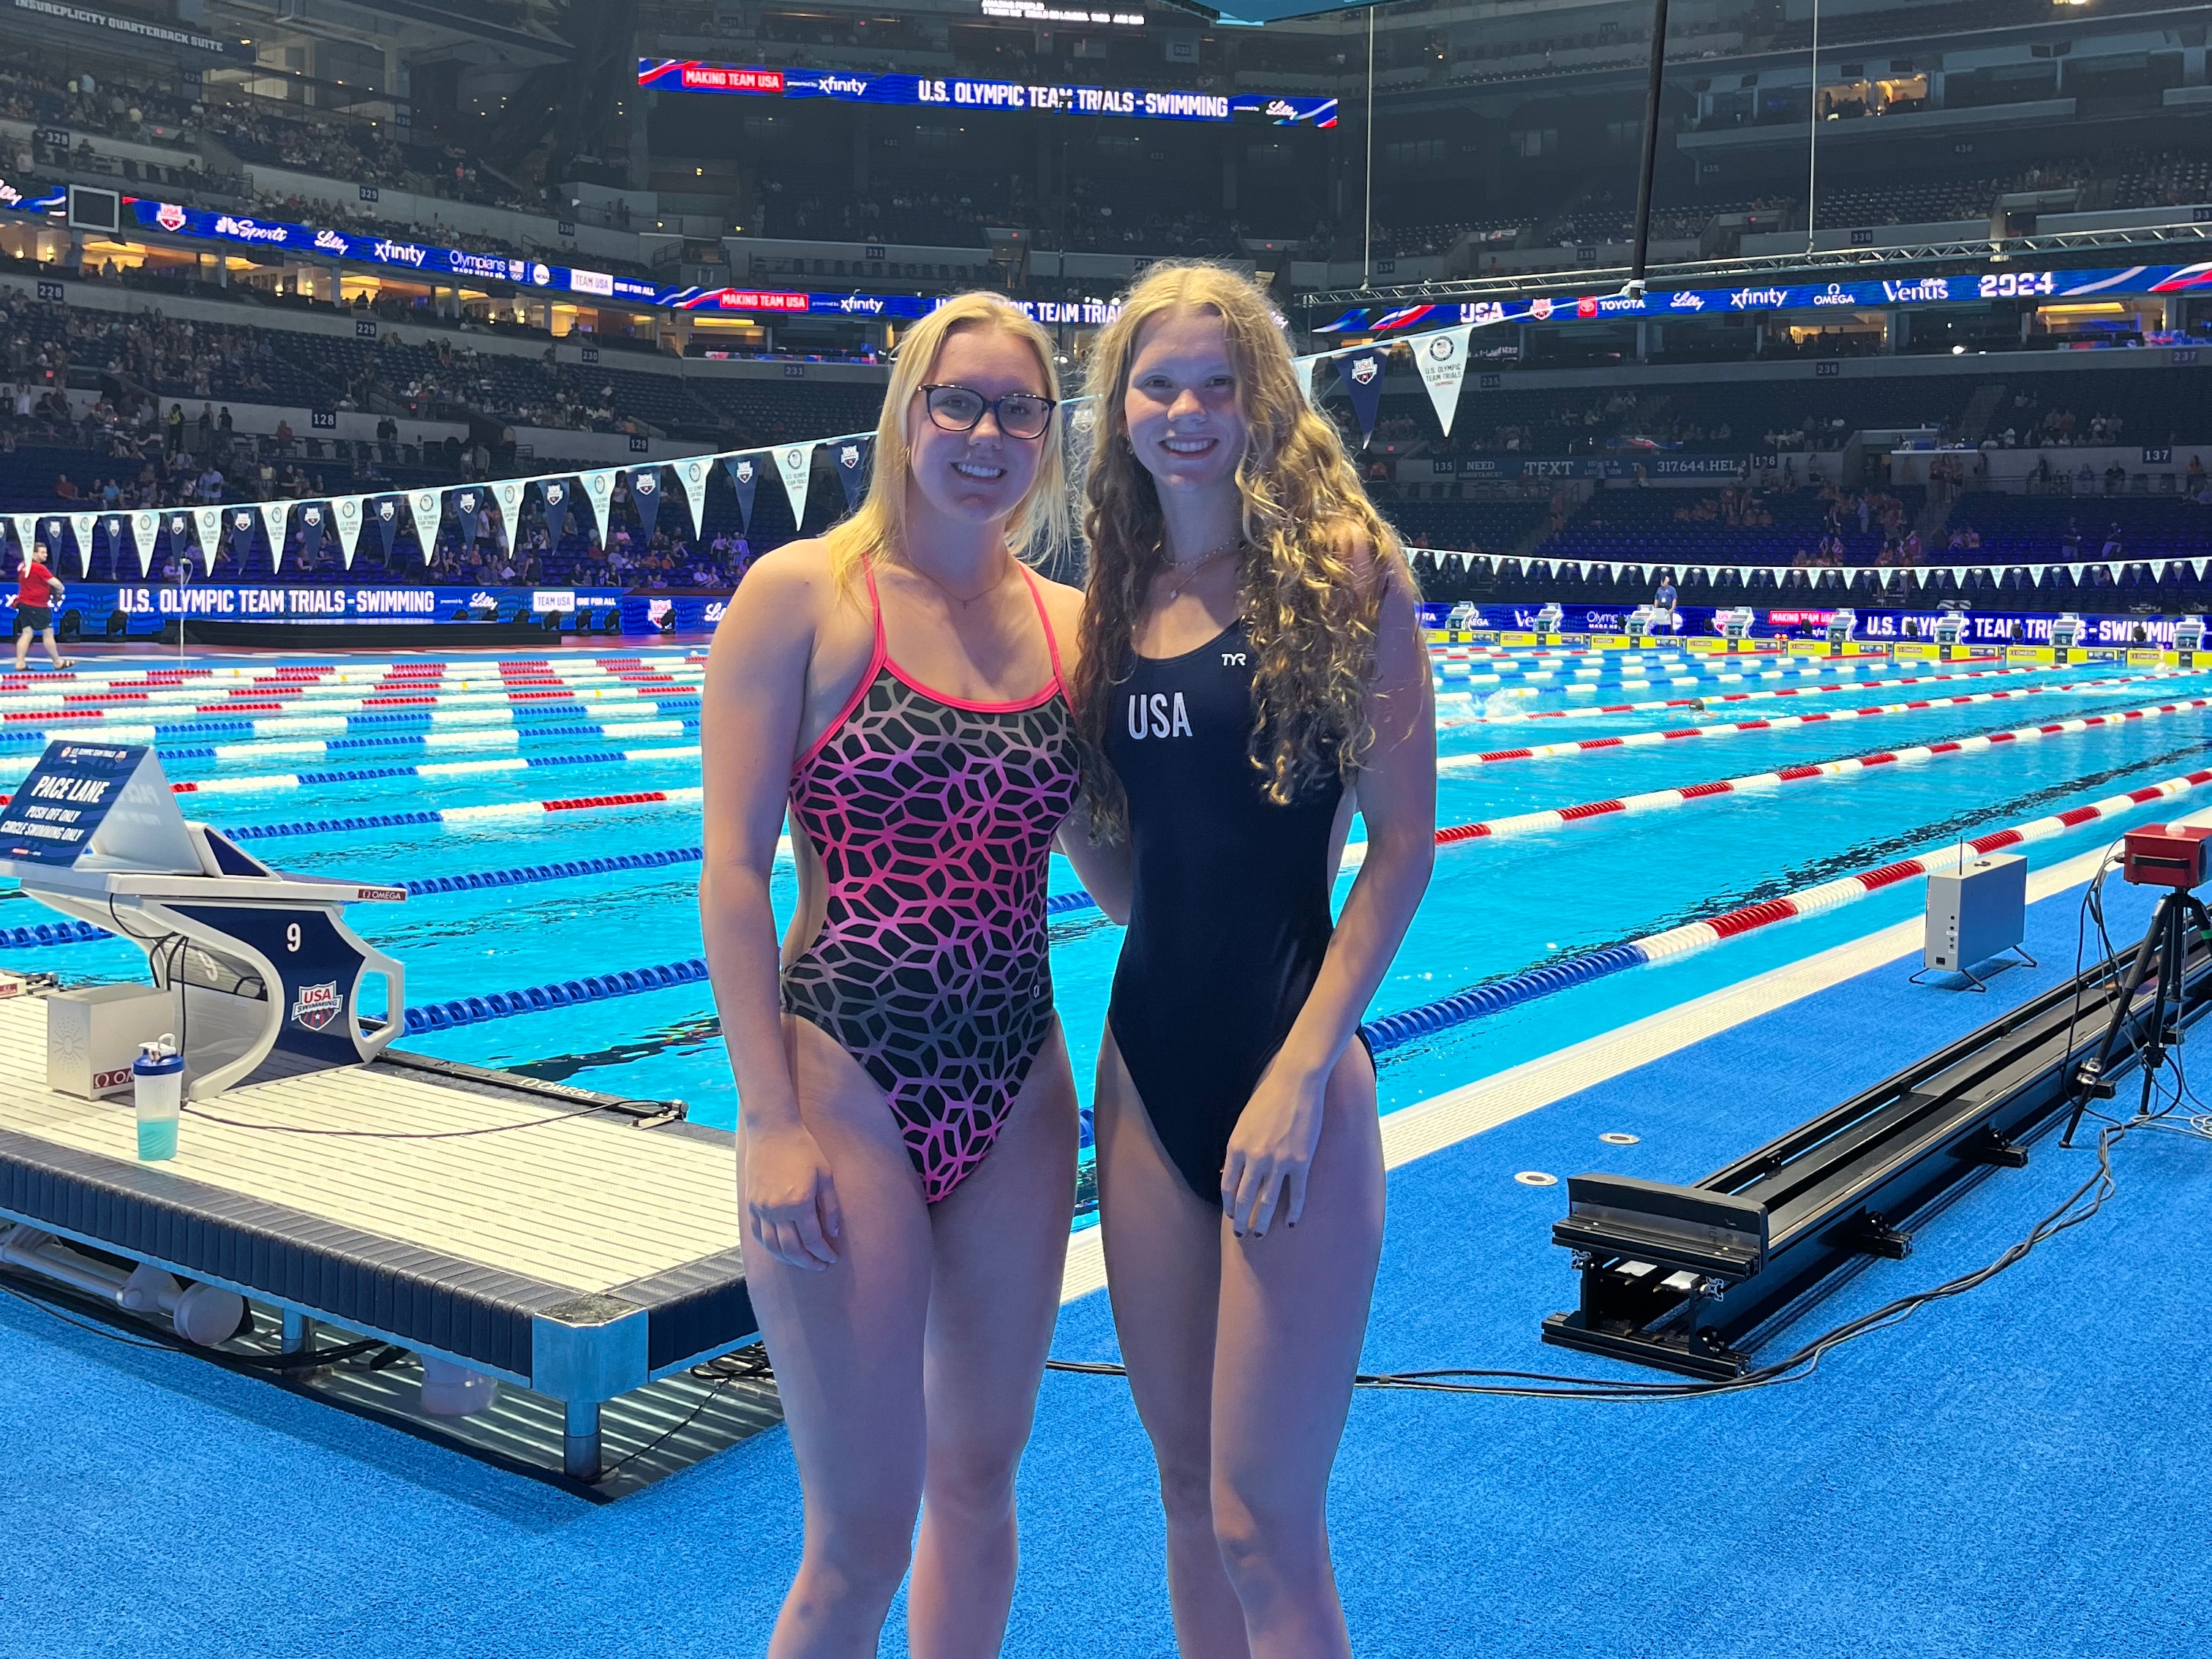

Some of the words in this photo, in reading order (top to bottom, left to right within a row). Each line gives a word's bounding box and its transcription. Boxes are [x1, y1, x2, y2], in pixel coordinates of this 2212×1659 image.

[108, 18, 188, 44] QUARTERBACK
[191, 36, 223, 52] SUITE
[686, 71, 726, 85] MAKING
[728, 72, 756, 86] TEAM
[757, 75, 780, 89] USA
[819, 77, 867, 96] xfinity
[919, 80, 950, 102] U.S.
[955, 83, 1025, 106] OLYMPIC
[1265, 100, 1298, 120] Lilly
[361, 189, 377, 199] 329
[560, 224, 573, 233] 330
[163, 207, 178, 216] USA
[238, 220, 287, 241] Sports
[315, 230, 349, 255] Lilly
[375, 240, 426, 266] xfinity
[868, 249, 883, 257] 331
[450, 251, 505, 272] Olympians
[40, 285, 62, 298] 228
[575, 274, 593, 286] TEAM
[596, 279, 609, 290] USA
[642, 286, 655, 296] ALL
[1883, 280, 1949, 301] Venus
[723, 294, 758, 306] MAKING
[760, 295, 784, 307] TEAM
[786, 296, 805, 308] USA
[840, 296, 884, 313] xfinity
[1461, 301, 1505, 323] USA
[1600, 299, 1645, 310] TOYOTA
[1670, 291, 1705, 310] Lilly
[1731, 288, 1787, 309] xfinity
[1814, 294, 1855, 305] OMEGA
[1037, 302, 1079, 323] TEAM
[358, 325, 375, 334] 229
[583, 351, 597, 361] 230
[786, 367, 803, 375] 231
[1358, 362, 1371, 370] USA
[1818, 365, 1837, 374] 236
[1426, 374, 1441, 382] TEAM
[1442, 371, 1462, 380] TRIALS
[1481, 377, 1500, 385] 235
[315, 413, 334, 426] 128
[631, 439, 647, 449] 129
[2146, 450, 2169, 461] 137
[1435, 462, 1453, 470] 135
[1467, 461, 1495, 470] NEED
[119, 588, 154, 612] U.S.
[159, 589, 235, 612] OLYMPIC
[238, 590, 285, 612] TEAM
[470, 592, 498, 610] Lilly
[538, 596, 555, 606] TEAM
[557, 598, 571, 608] USA
[603, 598, 617, 606] ALL
[654, 603, 669, 612] USA
[1718, 612, 1728, 620] US
[1771, 613, 1799, 622] MAKING
[1867, 617, 1897, 636] U.S.
[1222, 652, 1246, 666] TYR
[1128, 692, 1193, 740] USA
[30, 775, 75, 800] PACE
[66, 779, 110, 803] LANE
[25, 805, 48, 819] PUSH
[45, 807, 63, 821] OFF
[58, 808, 82, 823] ONLY
[0, 821, 28, 835] CIRCLE
[24, 823, 64, 839] SWIMMING
[61, 828, 85, 842] ONLY
[372, 890, 402, 900] OMEGA
[287, 923, 301, 952] 9
[304, 989, 331, 1004] USA
[297, 1000, 337, 1012] SWIMMING
